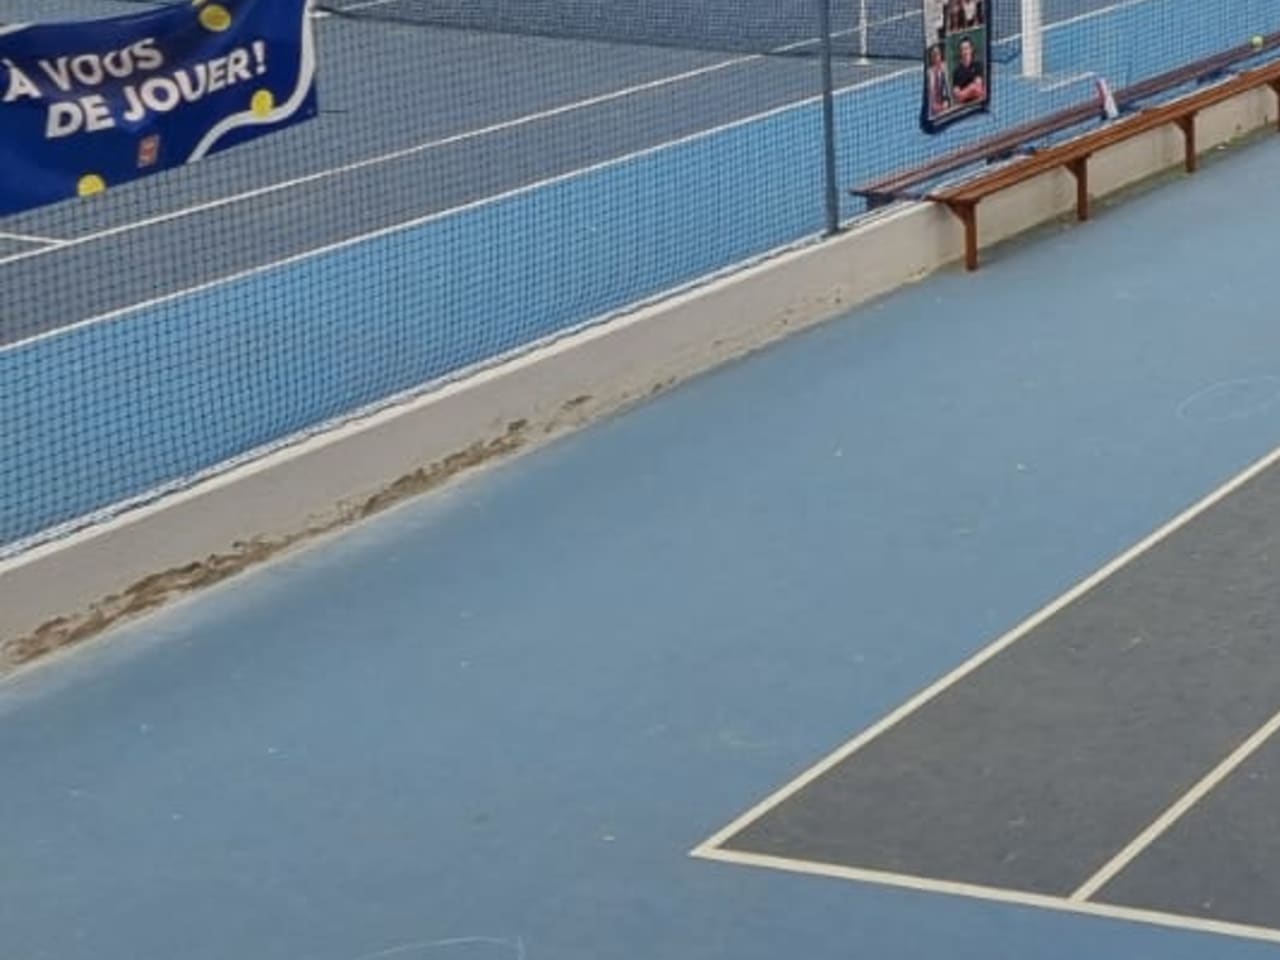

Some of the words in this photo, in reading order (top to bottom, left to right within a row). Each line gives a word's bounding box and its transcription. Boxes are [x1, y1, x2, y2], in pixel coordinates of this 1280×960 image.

[2, 57, 42, 102] À
[38, 38, 164, 91] VOUS
[45, 95, 116, 138] DE
